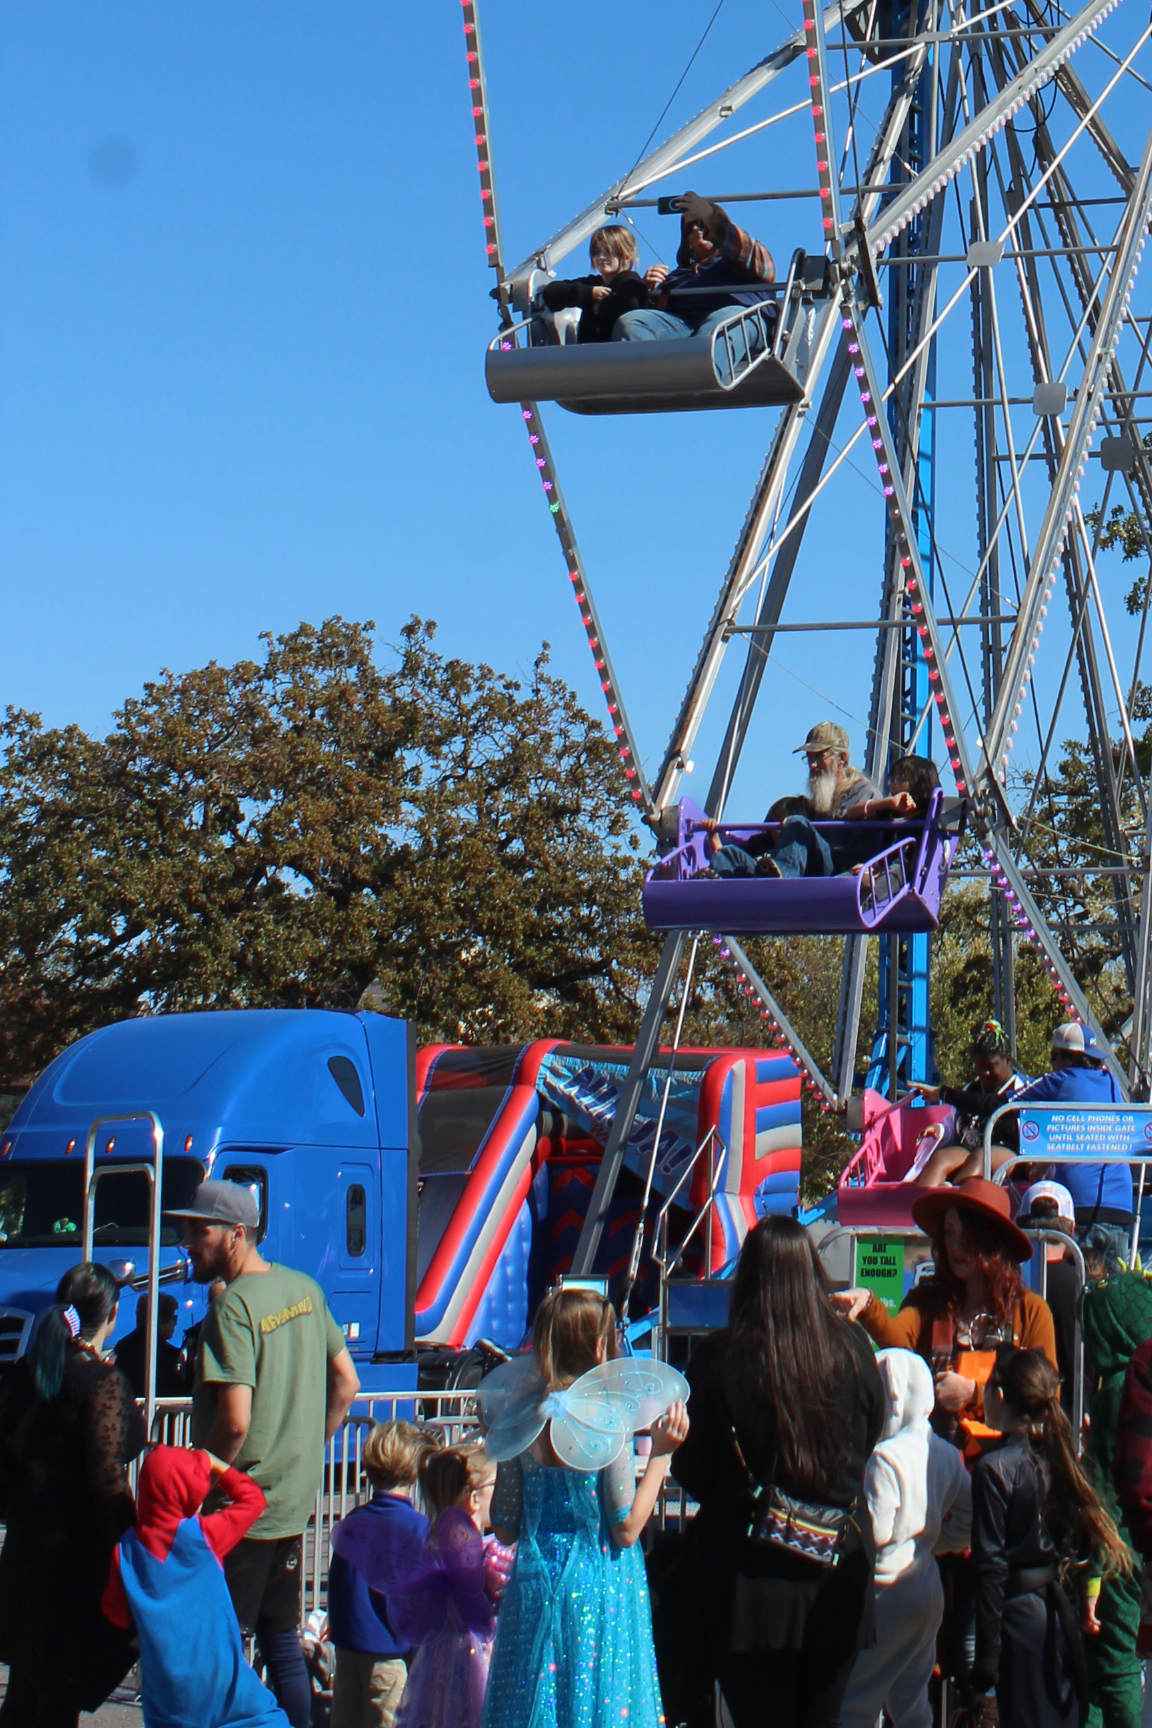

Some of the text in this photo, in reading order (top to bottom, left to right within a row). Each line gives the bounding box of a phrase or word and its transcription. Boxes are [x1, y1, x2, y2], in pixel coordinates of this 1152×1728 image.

[1051, 1115, 1134, 1123] NO CELL PHONES OR
[1047, 1124, 1136, 1132] PICTURES INSIDE GATE
[1049, 1134, 1130, 1142] UNTIL SEATED WITH
[1047, 1143, 1085, 1151] SEATBELT
[872, 1243, 887, 1253] ARE
[862, 1256, 896, 1265] YOU TALL
[860, 1268, 898, 1278] ENOUGH?
